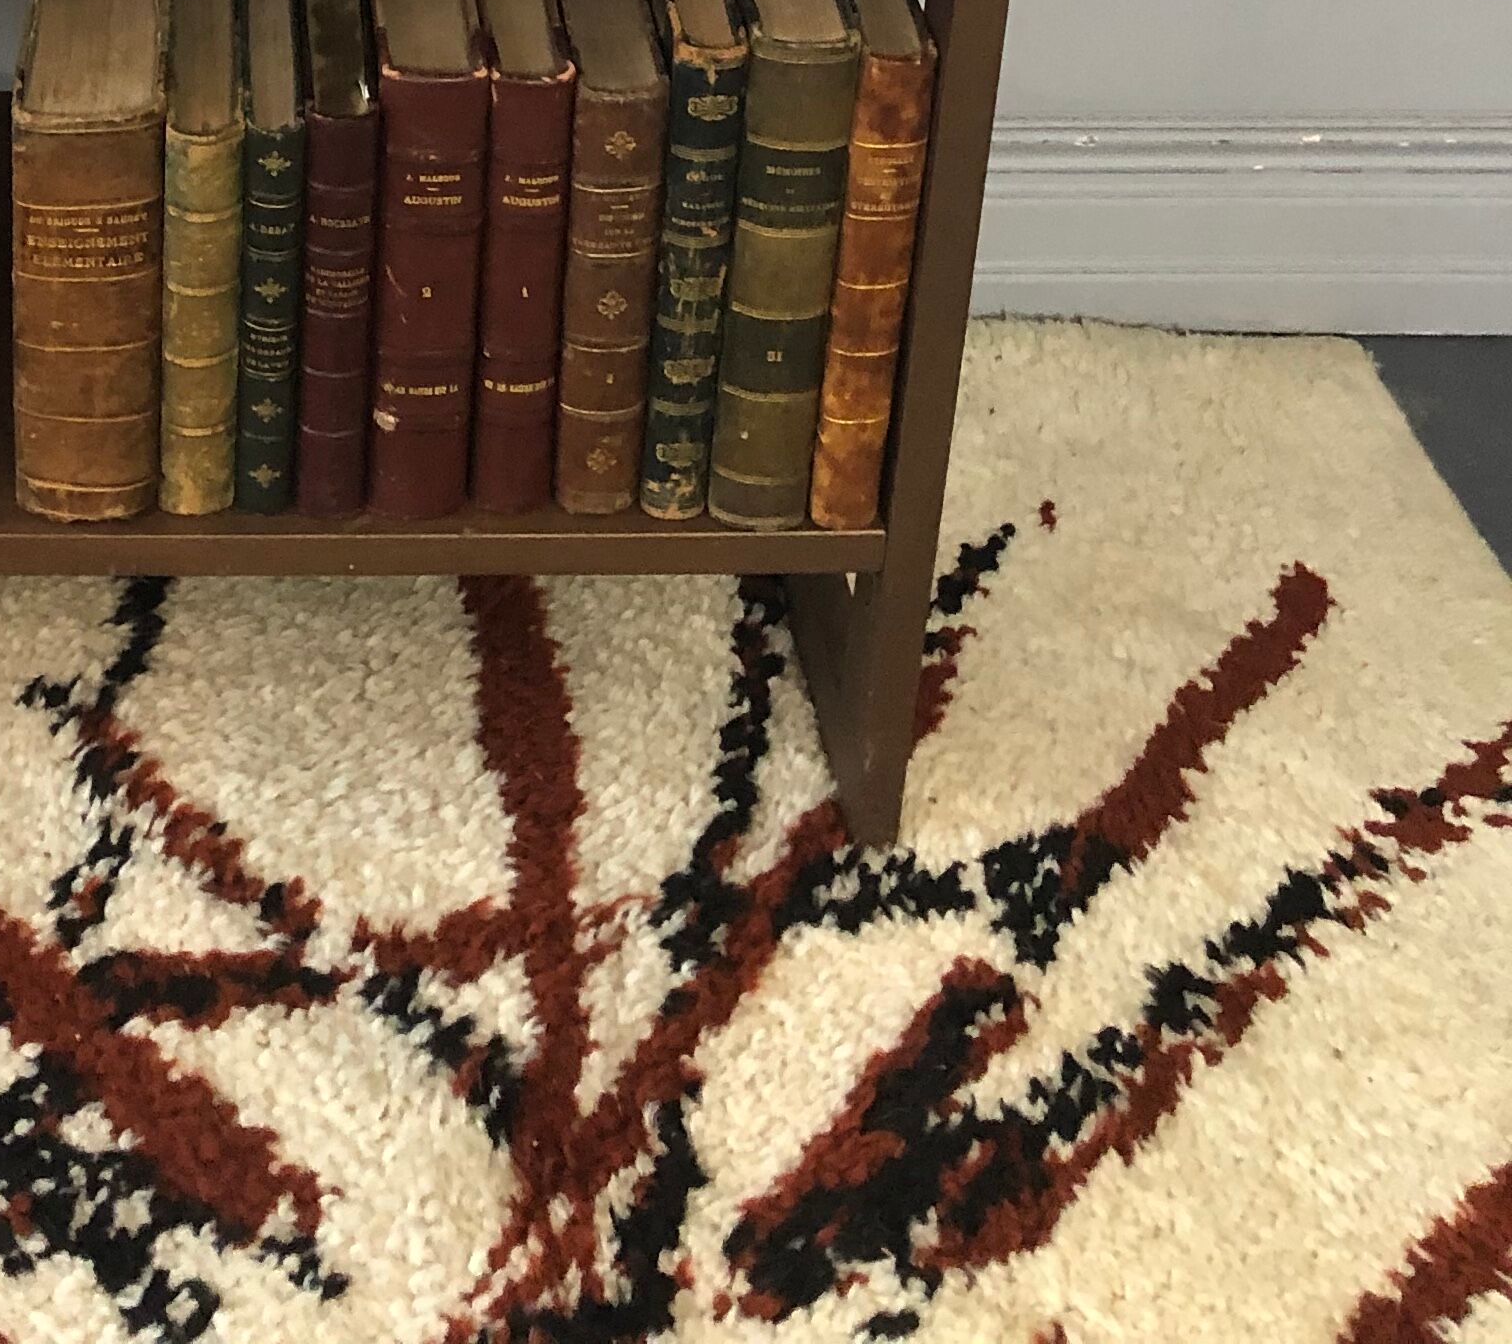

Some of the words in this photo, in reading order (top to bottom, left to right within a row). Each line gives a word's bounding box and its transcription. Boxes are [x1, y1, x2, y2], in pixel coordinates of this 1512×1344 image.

[403, 195, 463, 206] AUGUSTIN
[502, 194, 560, 207] AUGUSTIN
[422, 286, 432, 298] 2
[521, 286, 529, 298] 1
